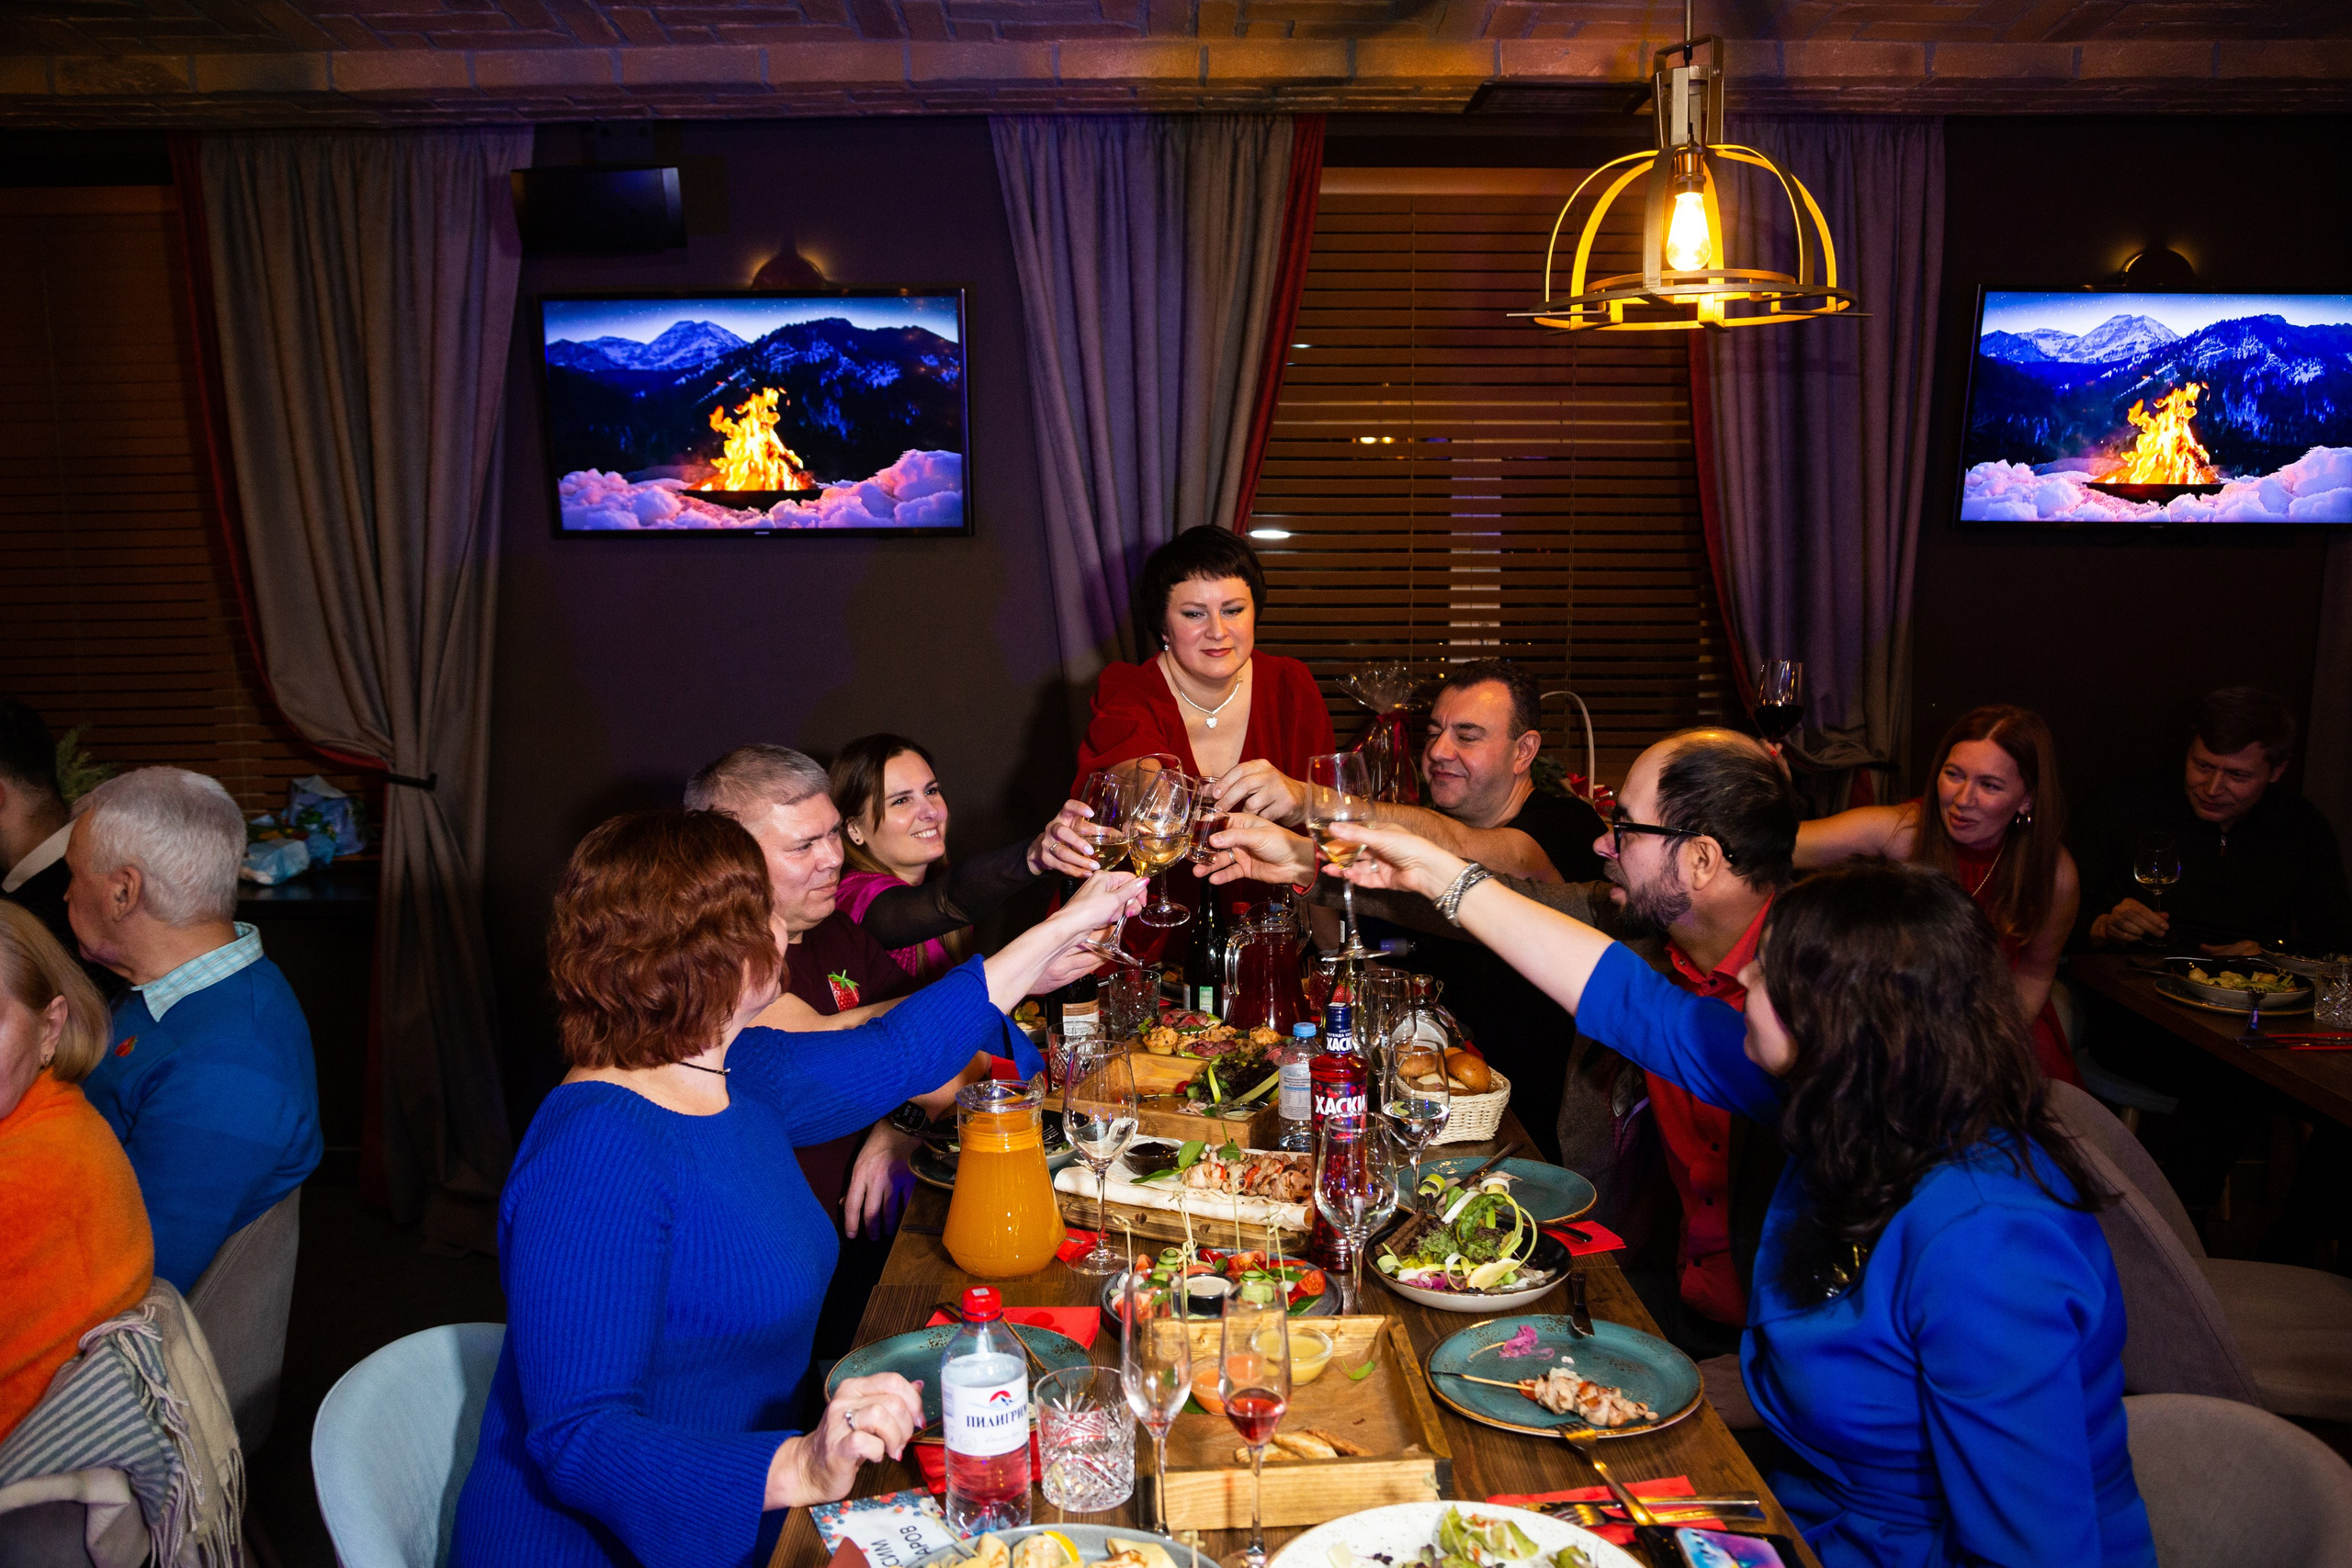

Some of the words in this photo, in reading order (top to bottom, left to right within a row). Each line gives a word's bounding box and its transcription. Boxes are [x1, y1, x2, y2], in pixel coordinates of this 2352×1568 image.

[1326, 1036, 1352, 1052] ХАСК
[1315, 1094, 1366, 1116] ХАСКИ
[870, 1539, 901, 1567] СИМ
